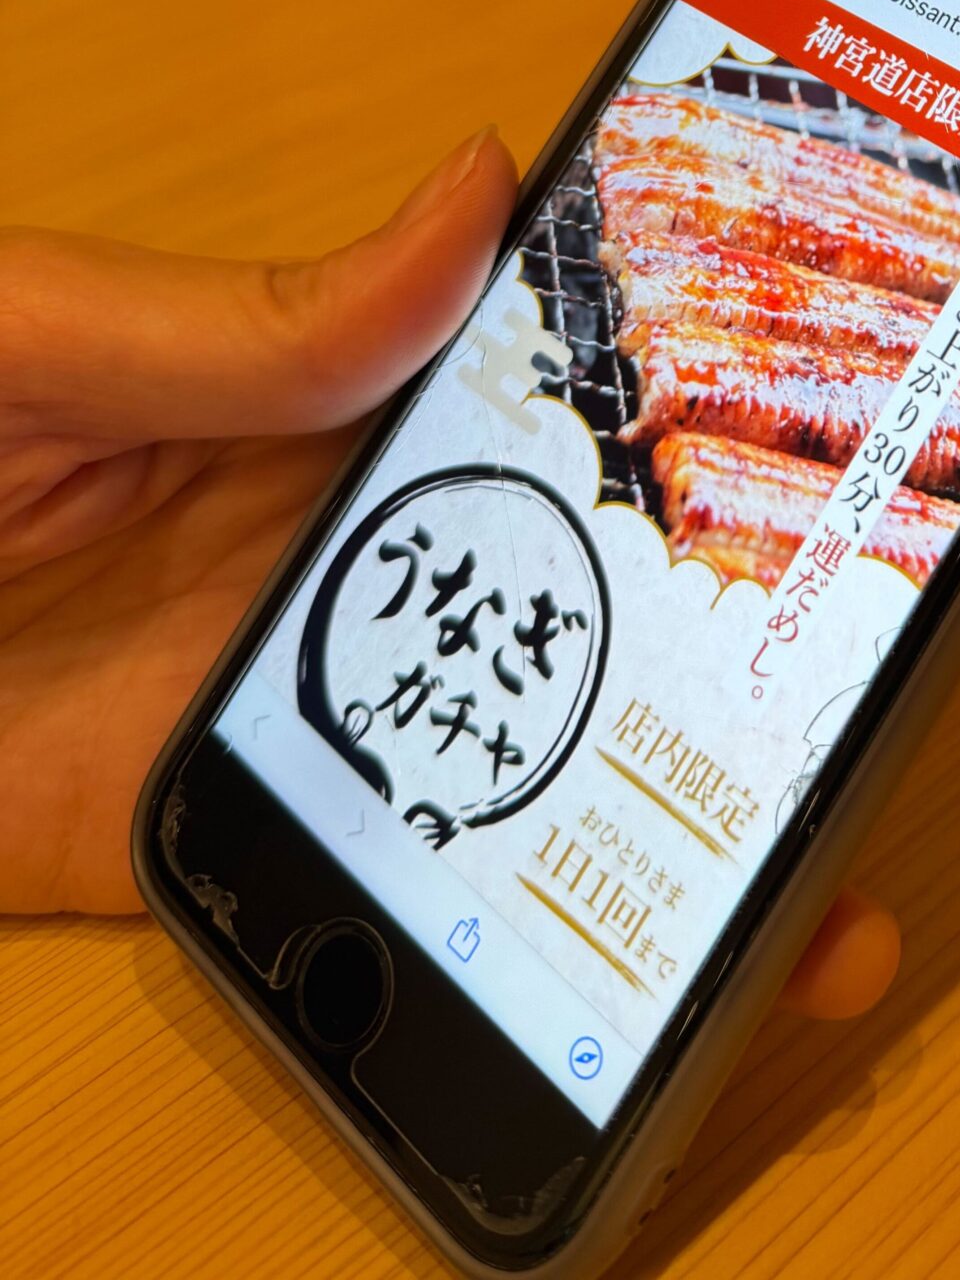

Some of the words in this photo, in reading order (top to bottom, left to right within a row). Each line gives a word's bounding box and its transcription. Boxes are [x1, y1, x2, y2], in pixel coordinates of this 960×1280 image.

[372, 523, 588, 695] うなぎ
[376, 662, 525, 785] ガチャ
[612, 697, 761, 844] 店内限定
[579, 807, 687, 910] おひとりさま
